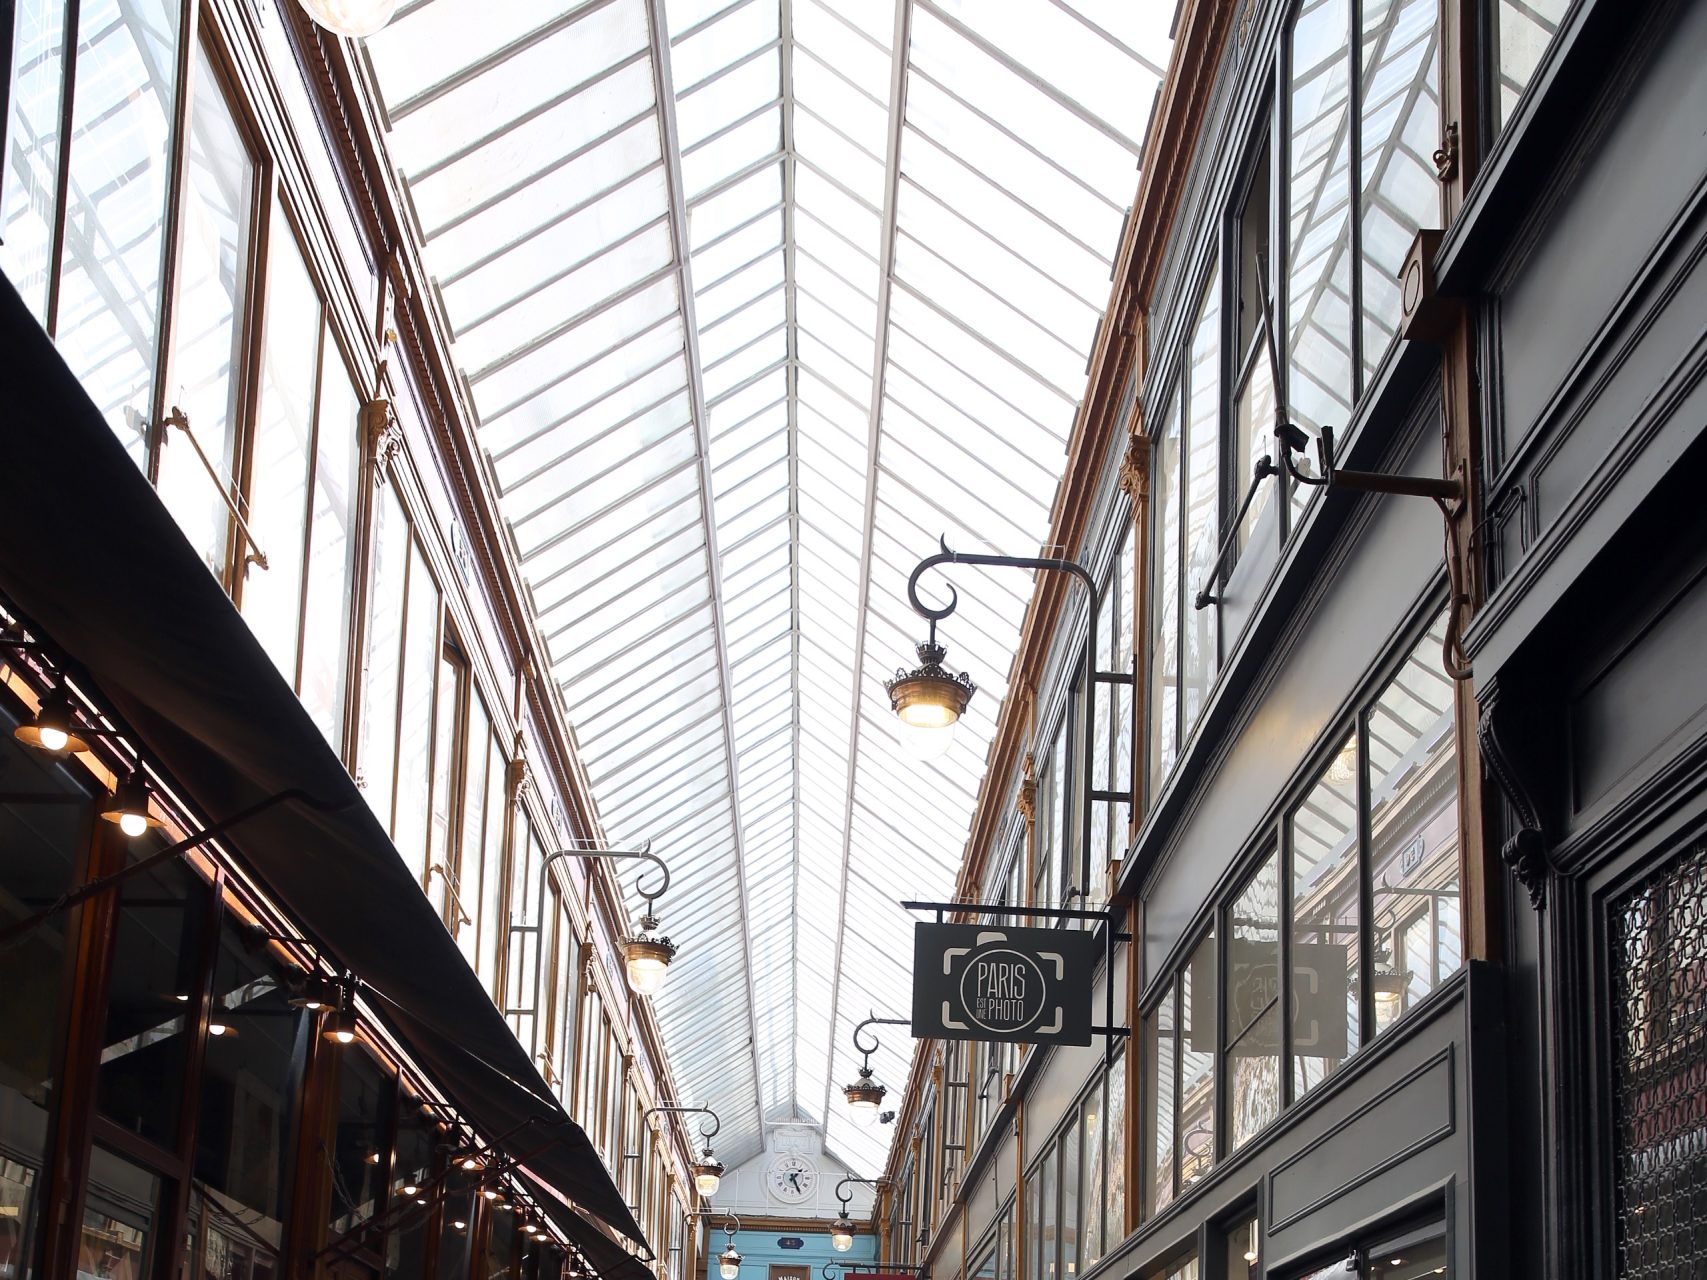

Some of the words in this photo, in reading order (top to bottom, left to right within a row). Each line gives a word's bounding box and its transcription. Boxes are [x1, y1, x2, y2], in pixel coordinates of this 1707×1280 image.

[977, 963, 1025, 999] PARIS
[977, 998, 987, 1008] EST
[988, 1000, 1024, 1021] PHOTO
[976, 1009, 987, 1020] UNE
